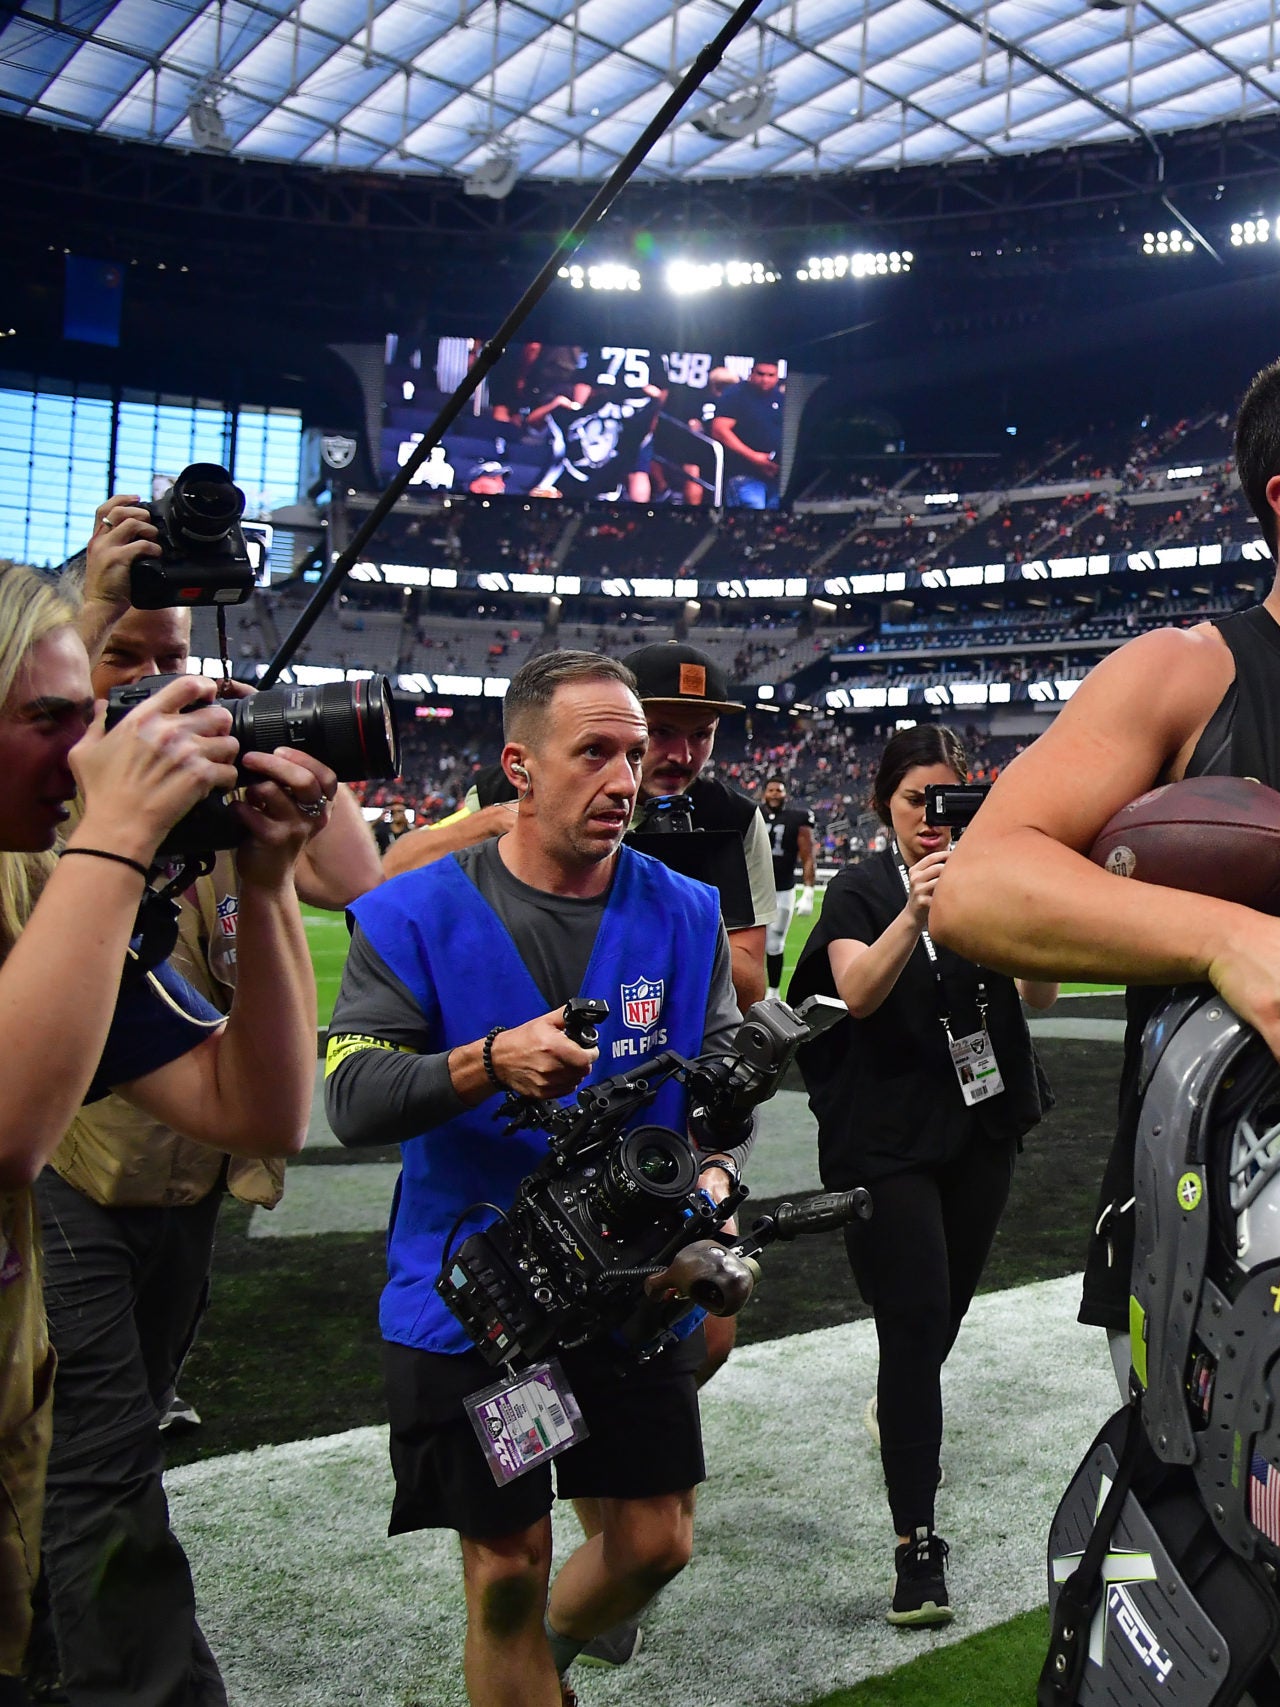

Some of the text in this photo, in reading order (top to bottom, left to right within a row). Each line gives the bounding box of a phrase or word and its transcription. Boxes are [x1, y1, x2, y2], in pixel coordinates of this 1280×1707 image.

[596, 346, 650, 388] 75
[627, 1000, 659, 1024] NFL
[612, 1038, 638, 1059] NFL
[553, 1219, 579, 1251] ALEXA
